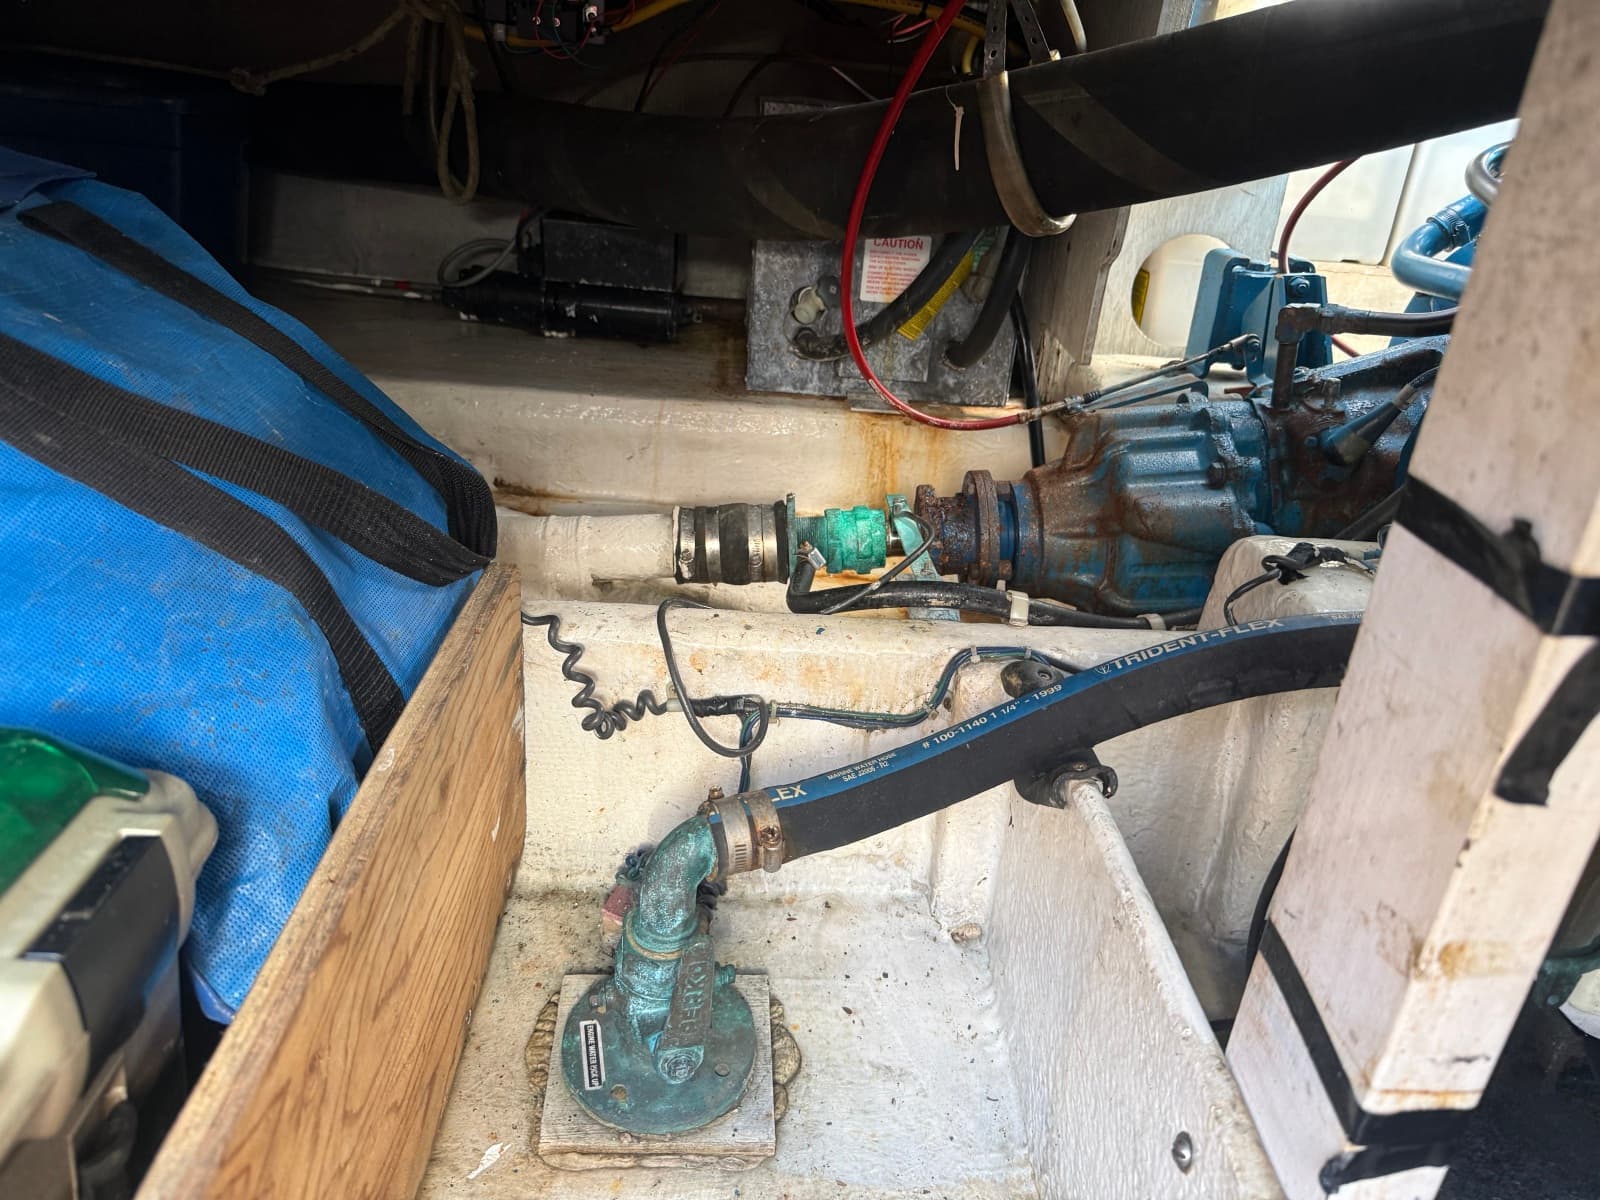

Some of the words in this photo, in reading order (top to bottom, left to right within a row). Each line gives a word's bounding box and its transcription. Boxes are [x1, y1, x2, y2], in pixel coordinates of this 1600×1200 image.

[873, 238, 924, 250] CAUTION
[1109, 618, 1284, 670] TRIDENT-FLEX
[933, 717, 988, 744] 100-1140
[1031, 684, 1063, 700] 1999
[842, 772, 858, 782] SAE
[588, 1045, 597, 1064] WATER
